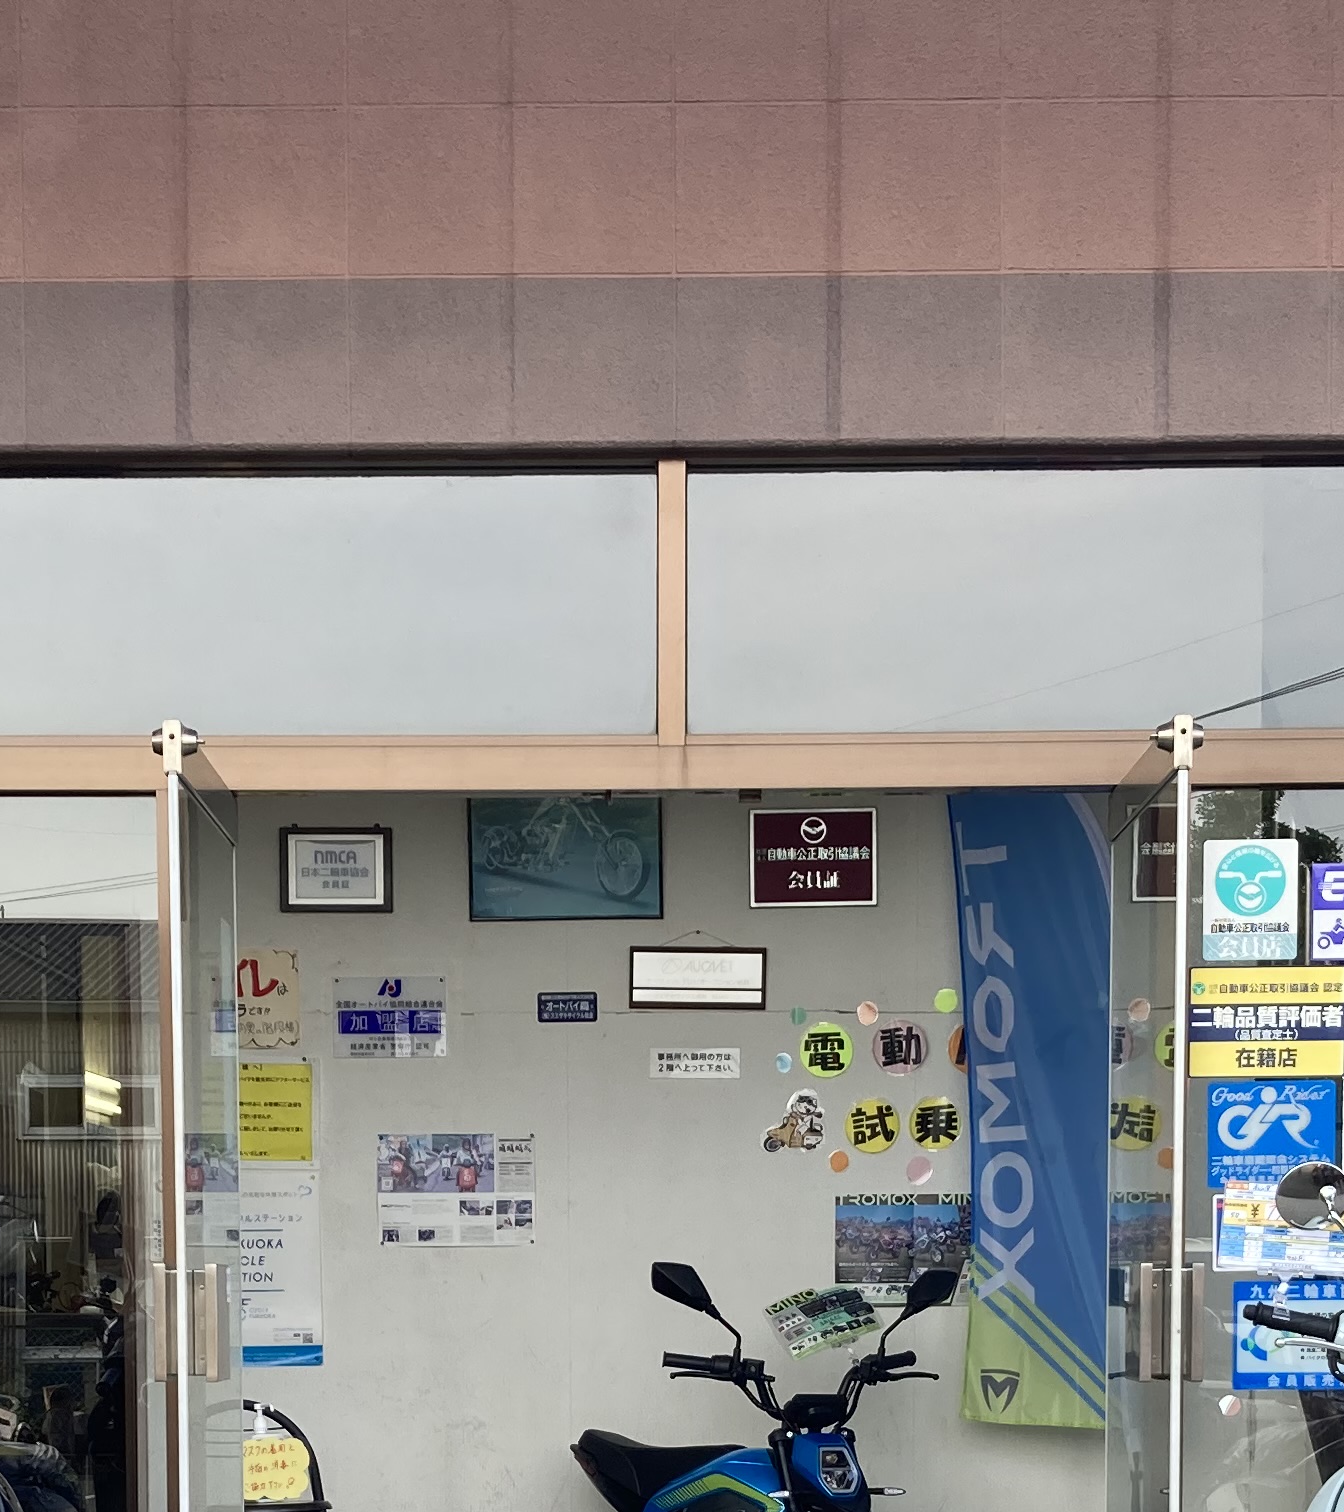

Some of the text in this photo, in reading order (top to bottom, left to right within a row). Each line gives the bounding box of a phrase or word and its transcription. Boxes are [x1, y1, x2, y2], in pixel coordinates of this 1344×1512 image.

[1218, 936, 1283, 959] 会員店
[1219, 983, 1320, 994] 自動車公正取引協議会
[1191, 1006, 1344, 1029] 二輪品質評価者
[657, 1053, 732, 1061] 事務所へ御用の方は
[1235, 1047, 1298, 1068] 在籍店
[838, 1193, 972, 1206] TROMOX MIN
[241, 1238, 284, 1250] KUOKA
[241, 1272, 274, 1283] TION
[765, 1288, 818, 1316] MINO
